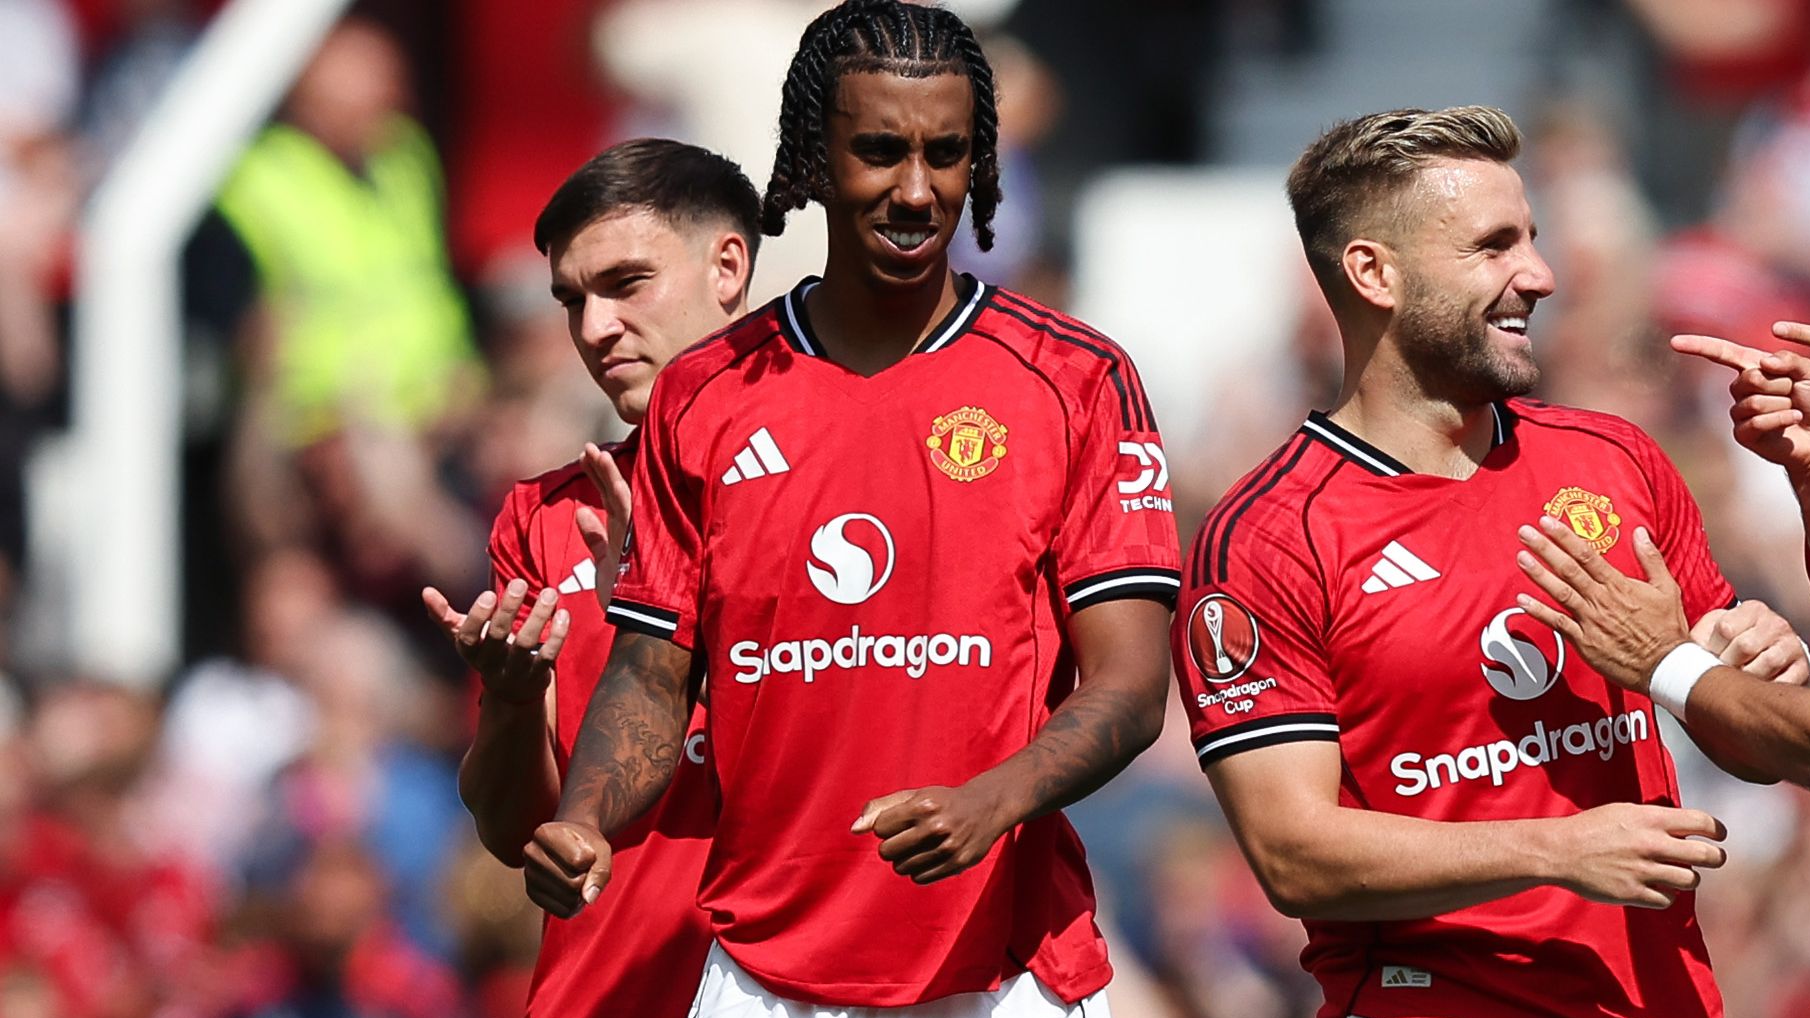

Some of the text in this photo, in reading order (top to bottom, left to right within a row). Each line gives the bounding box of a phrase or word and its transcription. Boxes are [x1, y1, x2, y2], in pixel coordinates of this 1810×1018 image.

[938, 412, 1002, 441] MANCHESTER
[940, 459, 986, 476] UNITED
[1119, 495, 1173, 514] TECHN
[1197, 677, 1277, 708] Snapdragon
[1224, 699, 1254, 714] Cup
[1390, 708, 1648, 797] Snapdragon
